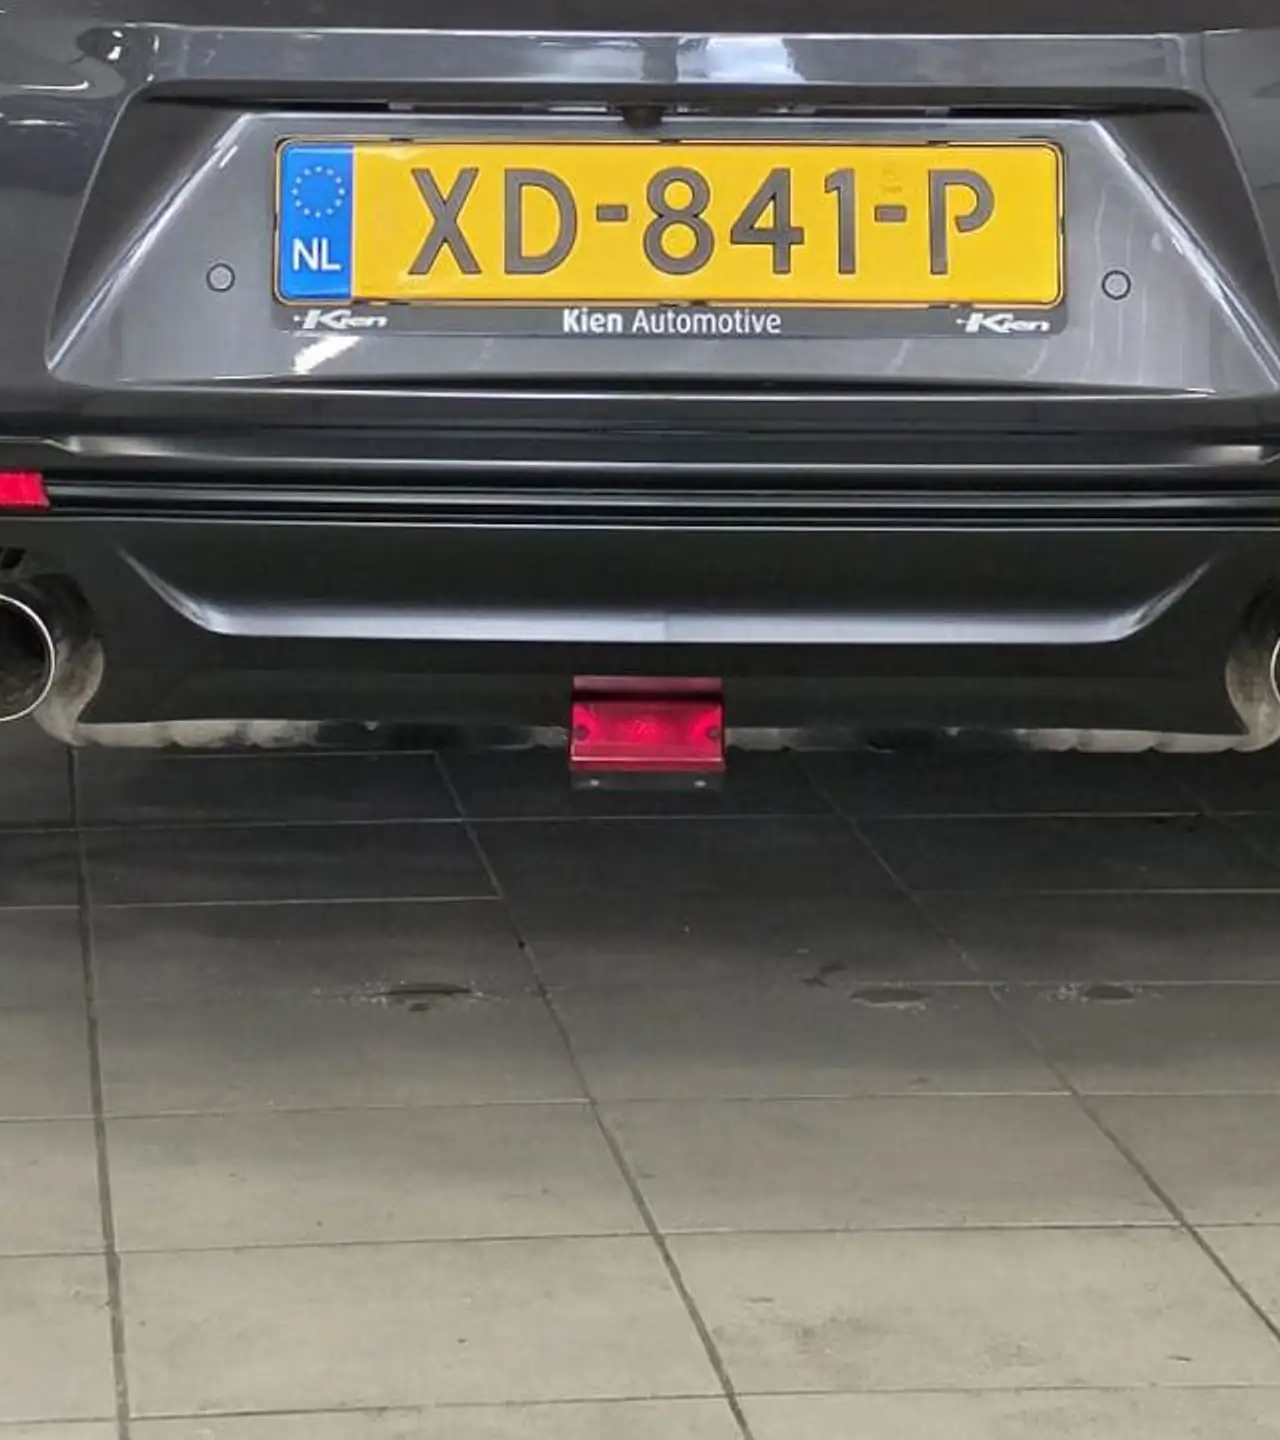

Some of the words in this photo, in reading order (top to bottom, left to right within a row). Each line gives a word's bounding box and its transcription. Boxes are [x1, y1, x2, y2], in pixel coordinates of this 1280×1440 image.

[406, 166, 995, 276] XD-841-P
[292, 237, 342, 272] NL
[562, 307, 623, 334] Kien
[632, 307, 783, 335] Automotive
